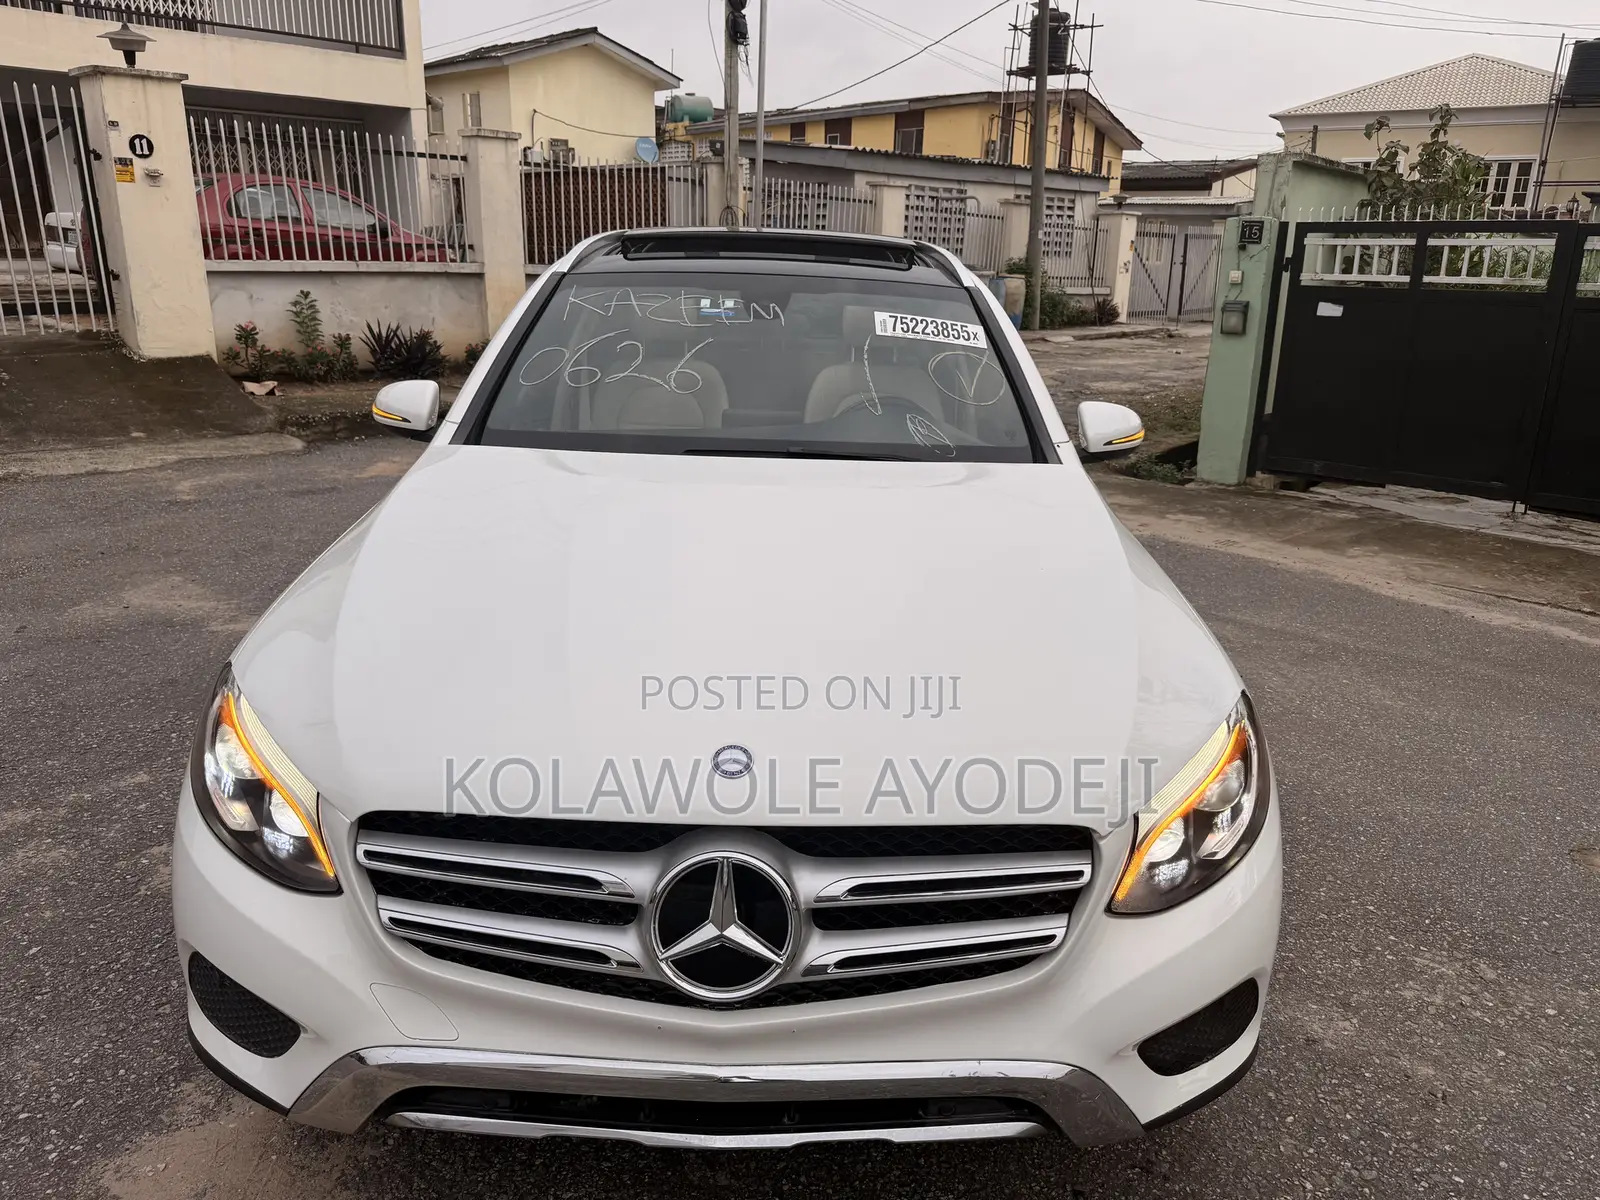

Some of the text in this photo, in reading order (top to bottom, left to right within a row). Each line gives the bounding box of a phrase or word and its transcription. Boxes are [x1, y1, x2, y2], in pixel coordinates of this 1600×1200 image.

[133, 137, 150, 155] 11
[1243, 226, 1260, 239] 15
[563, 284, 785, 327] KAZEEM
[519, 328, 715, 394] 0626
